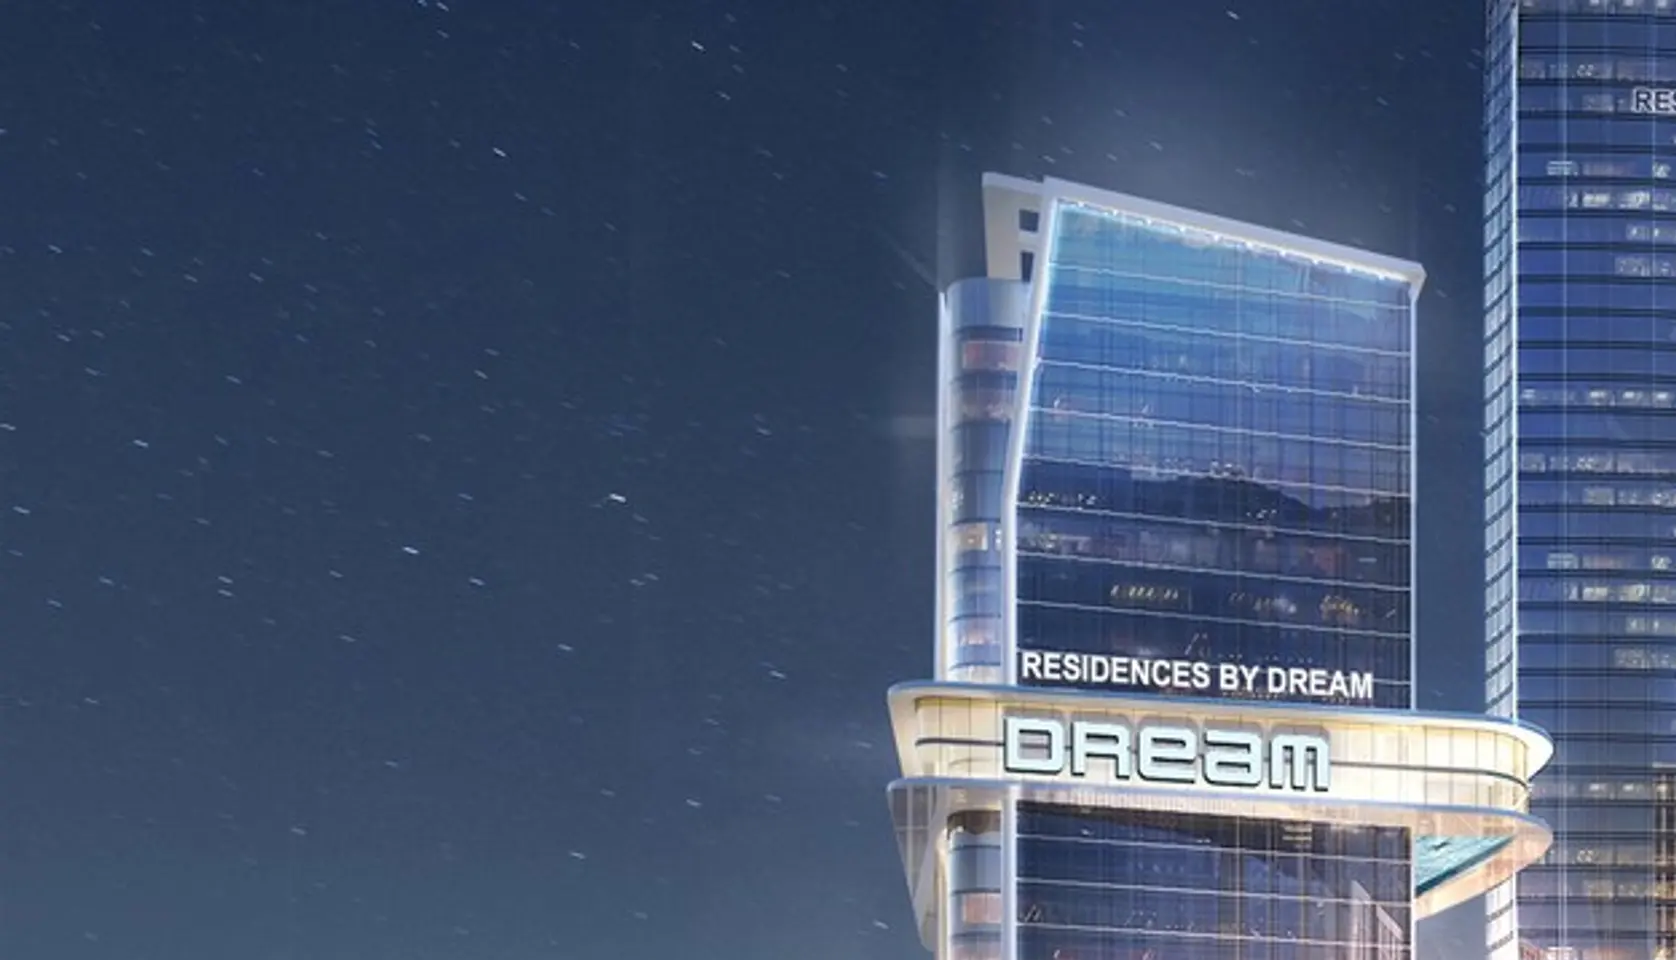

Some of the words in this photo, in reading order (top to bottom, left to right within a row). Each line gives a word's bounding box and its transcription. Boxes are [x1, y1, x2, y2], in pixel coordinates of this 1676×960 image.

[1021, 651, 1211, 689] RESIDENCES
[1219, 663, 1260, 693] BY
[1267, 666, 1374, 699] DREAM
